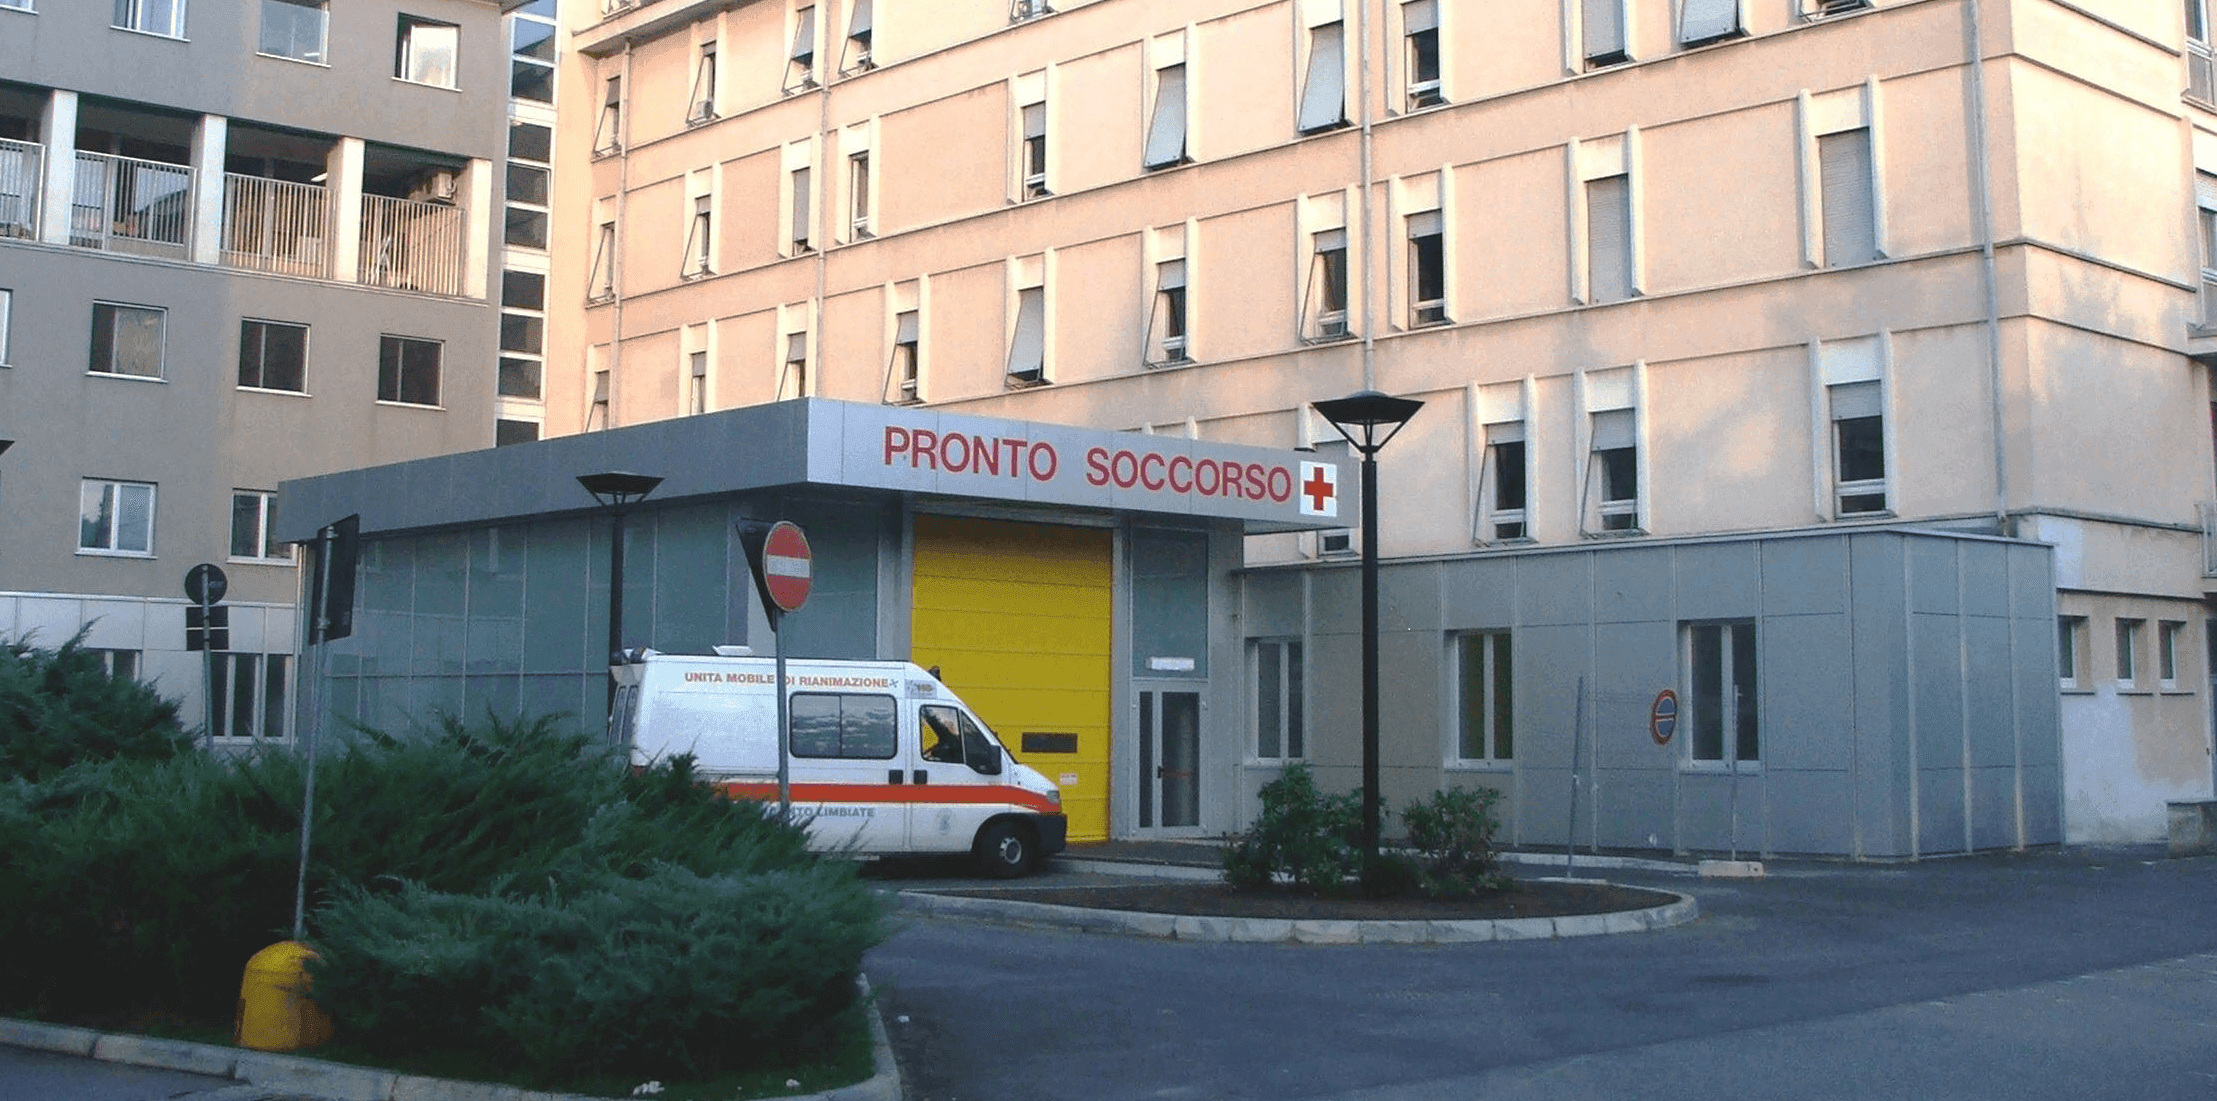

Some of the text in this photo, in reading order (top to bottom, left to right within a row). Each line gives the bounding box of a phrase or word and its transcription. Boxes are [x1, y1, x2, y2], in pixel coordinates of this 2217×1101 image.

[884, 425, 1293, 503] PRONTO SOCCORSO
[684, 672, 722, 683] UNITA
[726, 673, 775, 684] MOBILE
[799, 676, 889, 688] RIANIMAZIONE
[817, 807, 876, 818] LIMBIATE
